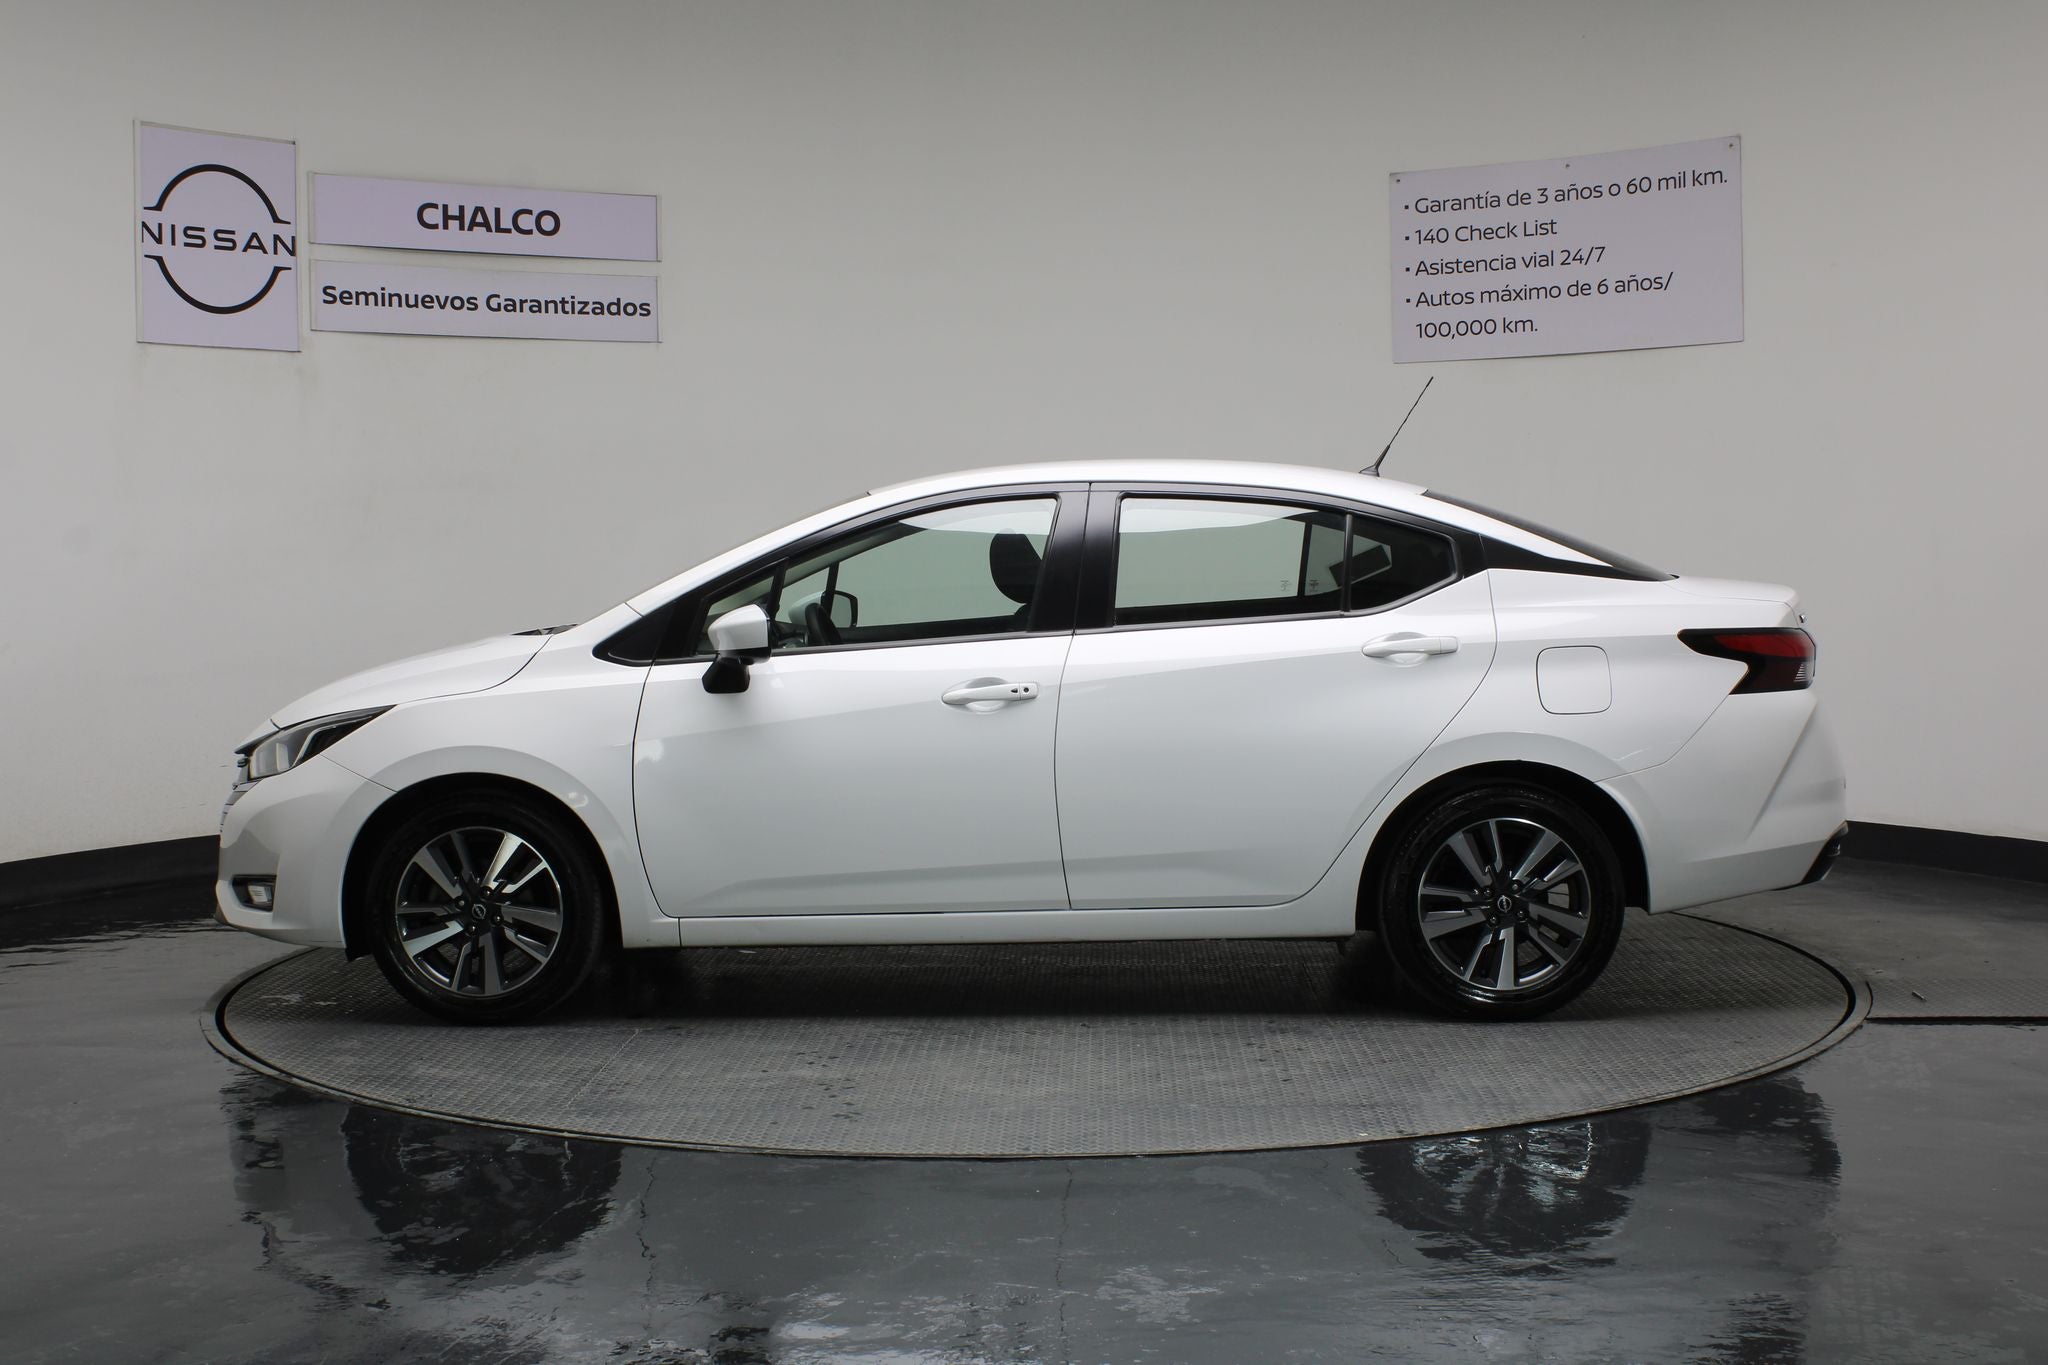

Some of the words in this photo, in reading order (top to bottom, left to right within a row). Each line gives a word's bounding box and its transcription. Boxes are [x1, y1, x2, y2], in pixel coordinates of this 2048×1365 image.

[1415, 192, 1500, 213] Garantía
[1507, 190, 1531, 206] de
[1538, 188, 1548, 203] 3
[1555, 184, 1603, 202] años
[1609, 184, 1620, 196] o
[1627, 177, 1651, 194] 60
[1658, 171, 1685, 190] mil
[1693, 170, 1727, 186] km.
[417, 203, 560, 236] CHALCO
[1415, 228, 1449, 244] 140
[1455, 222, 1517, 241] Check
[1524, 220, 1557, 236] List
[141, 221, 296, 257] NISSAN
[1416, 255, 1516, 276] Asistencia
[1522, 250, 1553, 268] vial
[1561, 247, 1605, 265] 24/7
[323, 286, 478, 311] Seminuevos
[486, 294, 651, 316] Garantizados
[1416, 291, 1474, 307] Autos
[1481, 285, 1561, 303] máximo
[1567, 280, 1591, 296] de
[1598, 279, 1608, 294] 6
[1615, 272, 1673, 293] años/
[1416, 319, 1496, 339] 100,000
[1503, 318, 1537, 333] km.
